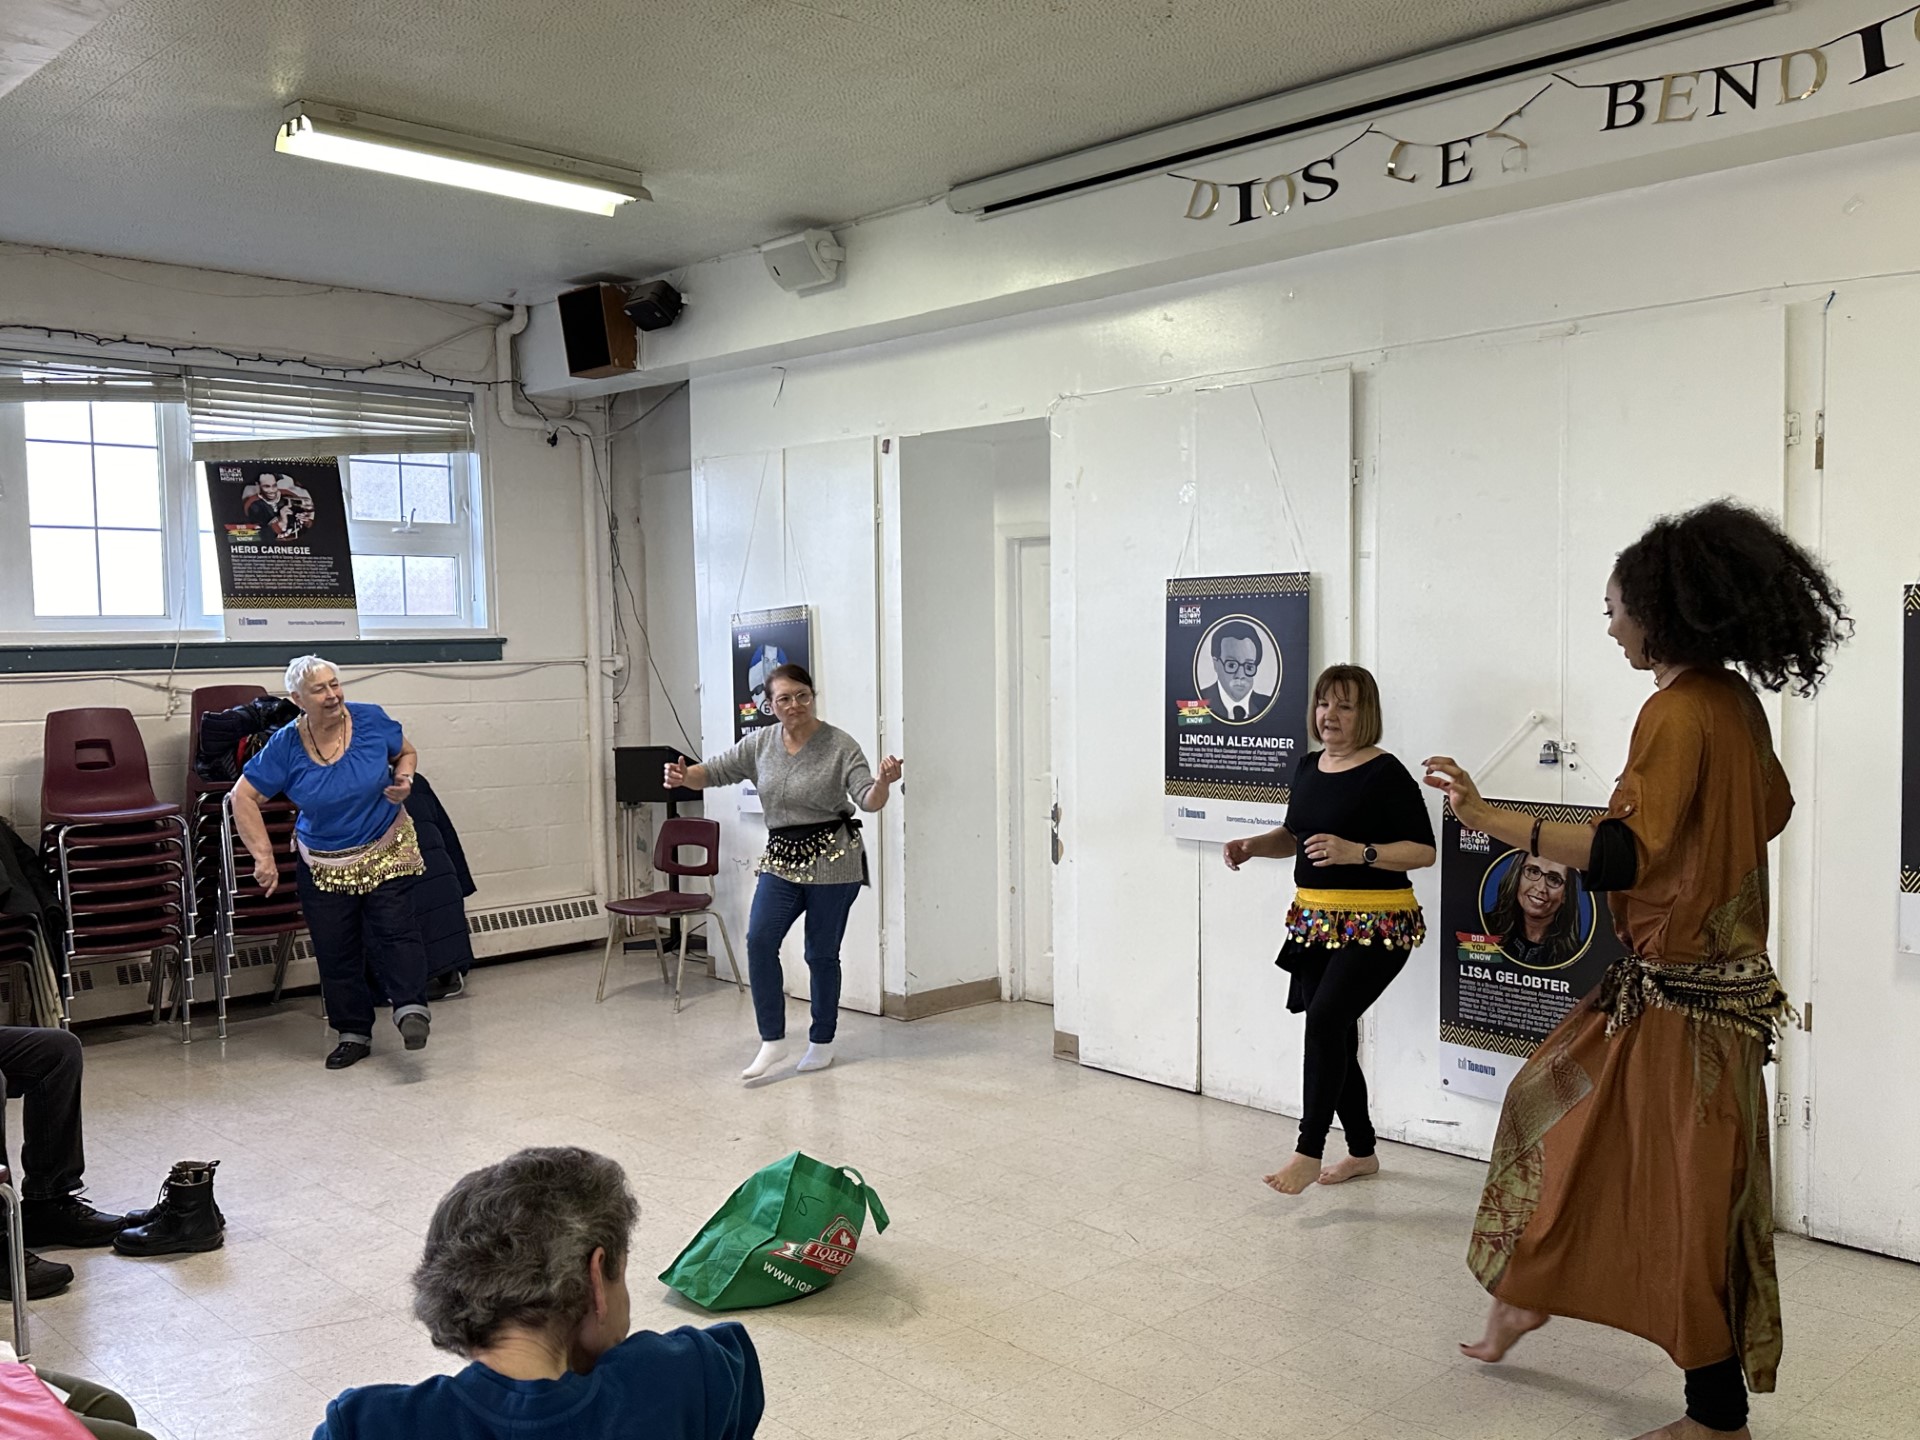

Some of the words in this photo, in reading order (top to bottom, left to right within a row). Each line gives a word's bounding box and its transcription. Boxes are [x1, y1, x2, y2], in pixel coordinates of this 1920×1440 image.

[1183, 156, 1339, 226] DIOS
[1600, 6, 1920, 132] BENDI
[230, 545, 258, 554] HERB
[261, 546, 311, 555] CARNEGIE
[1179, 733, 1225, 748] LINCOLN
[1226, 735, 1295, 750] ALEXANDER
[1460, 829, 1490, 841] BLACK
[1460, 836, 1490, 845] HISTORY
[1460, 842, 1490, 852] MONTH
[1471, 934, 1485, 942] DID
[1469, 952, 1492, 961] KNOW
[1459, 964, 1492, 982] LISA
[1495, 970, 1571, 994] GELOBTER
[1467, 1060, 1496, 1076] TORONTO
[763, 1261, 816, 1293] WWW.IQB
